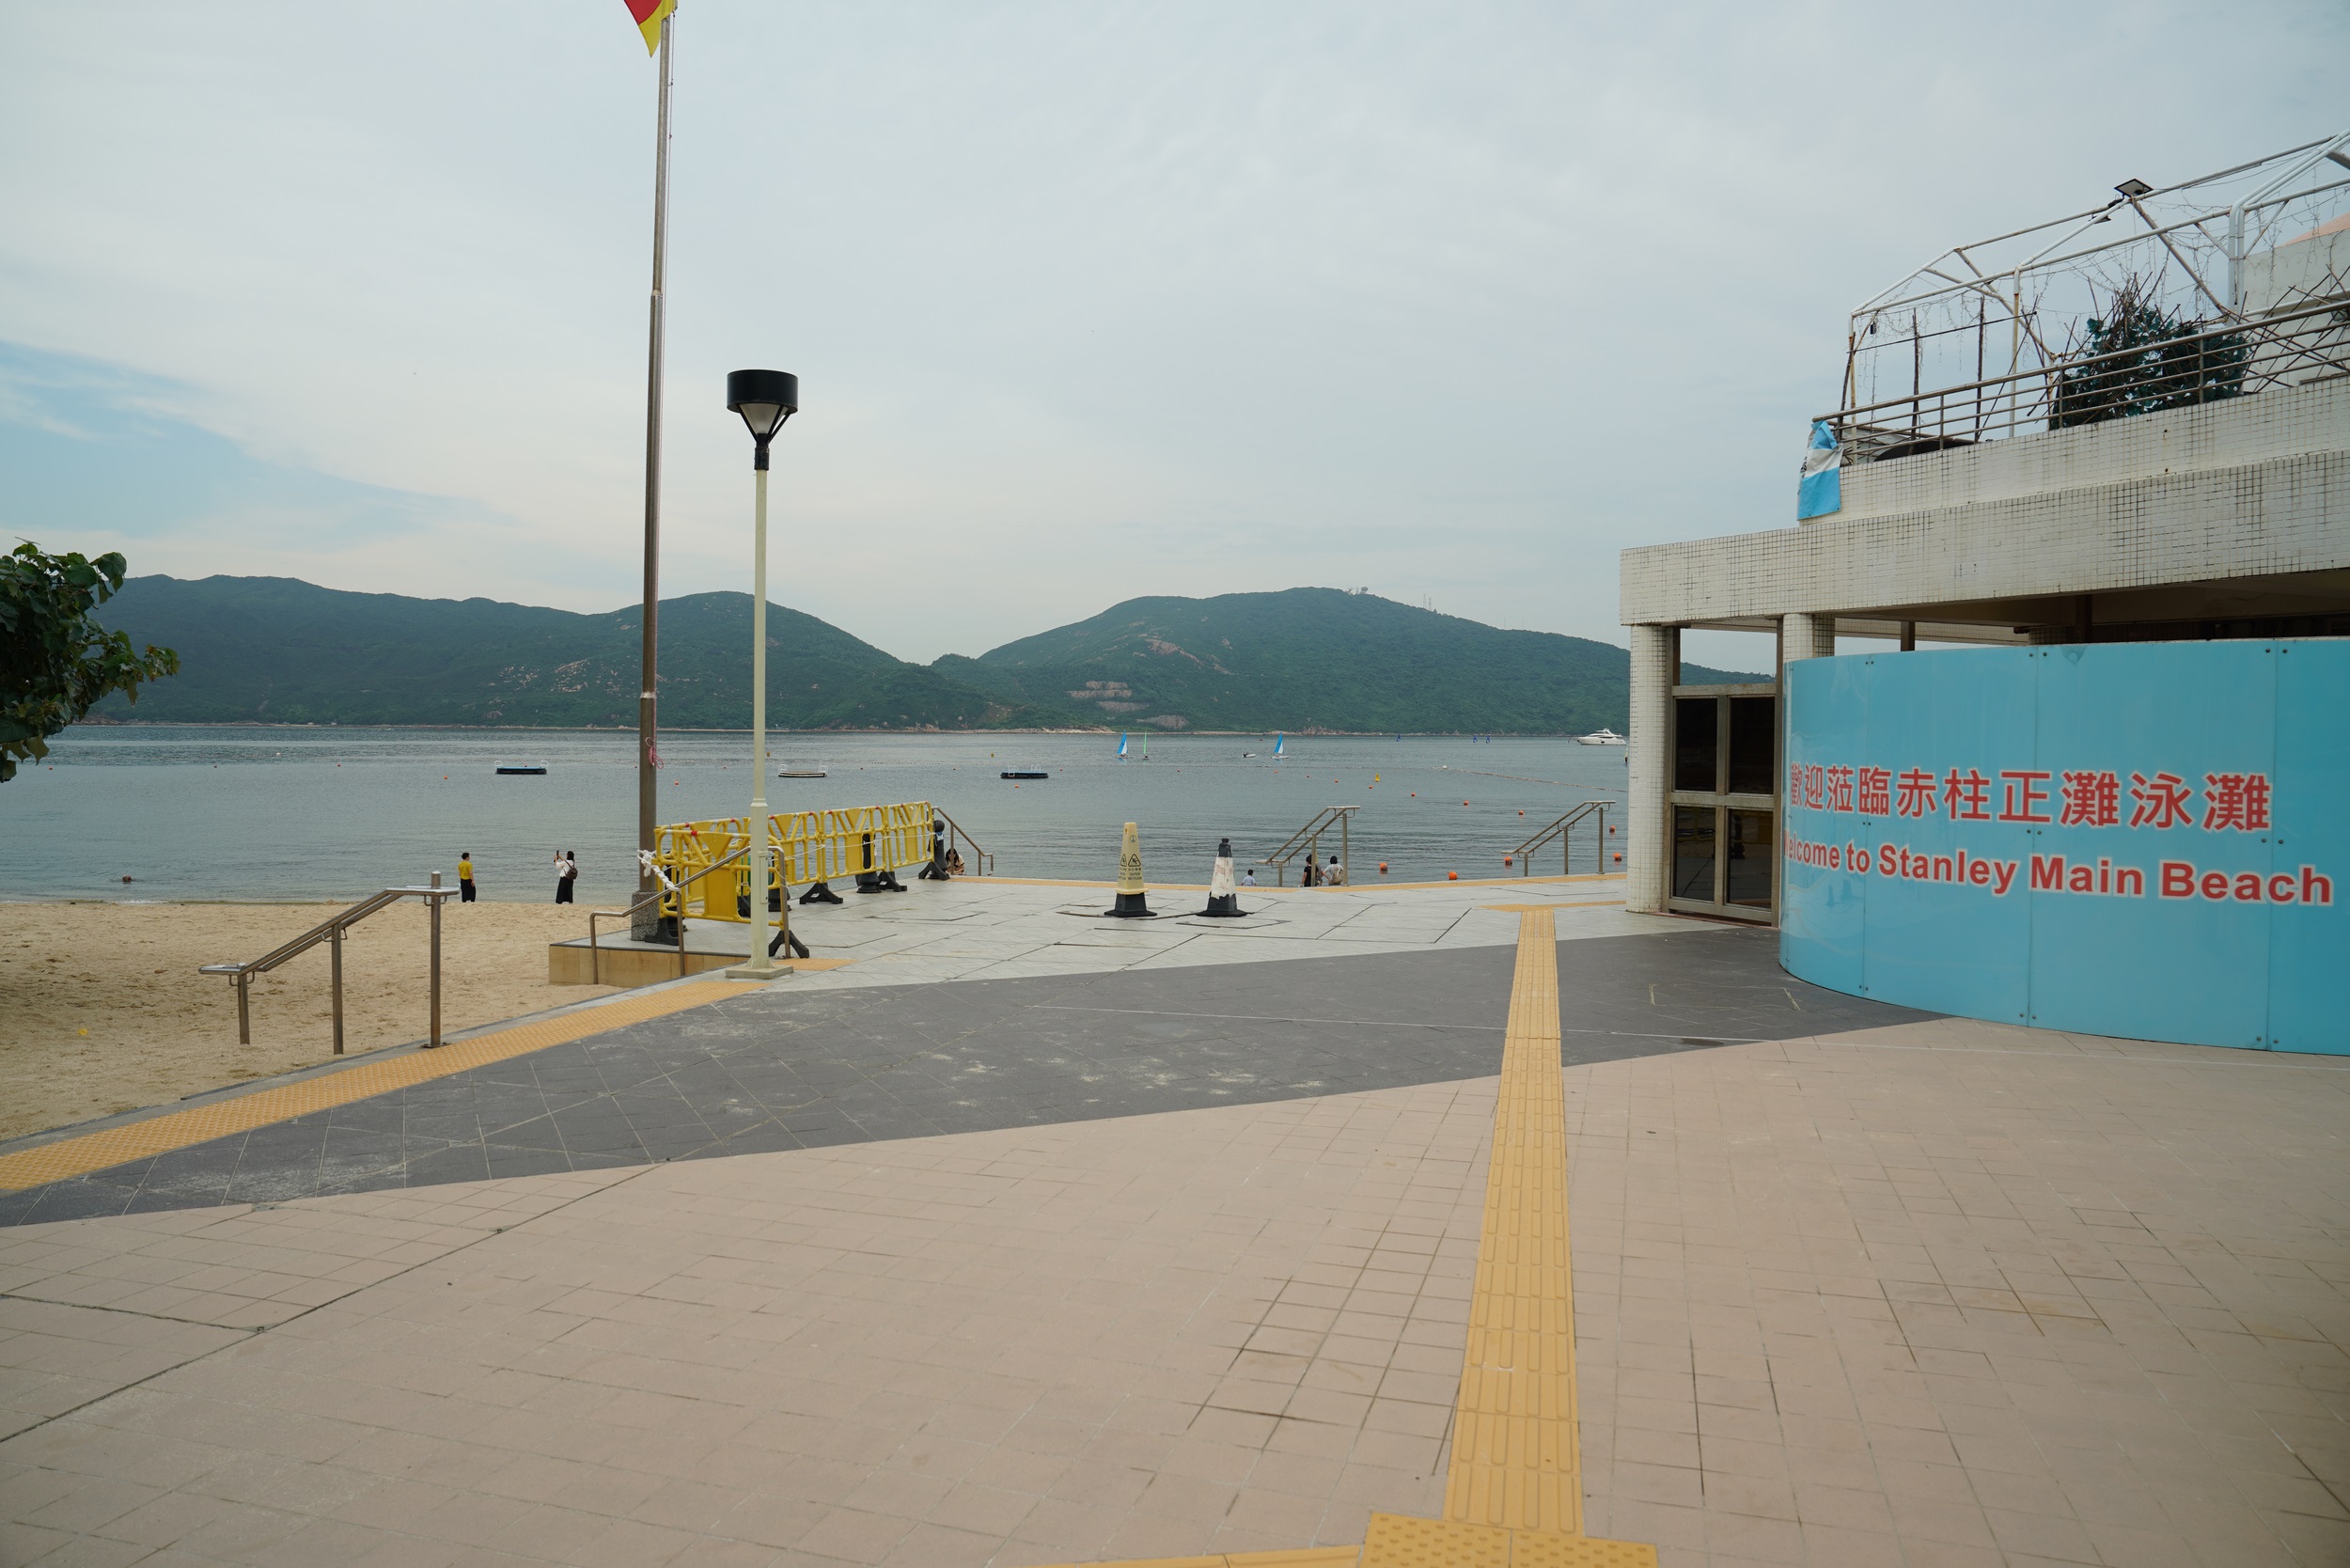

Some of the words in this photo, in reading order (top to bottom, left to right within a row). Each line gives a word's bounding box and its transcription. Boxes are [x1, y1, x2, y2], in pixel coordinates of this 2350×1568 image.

[1790, 762, 2271, 831] 歡迎蒞臨赤柱正灘泳灘
[1846, 841, 1871, 873] to
[1878, 843, 2017, 894] Stanley
[2030, 856, 2143, 896] Main
[2162, 862, 2331, 903] Beach
